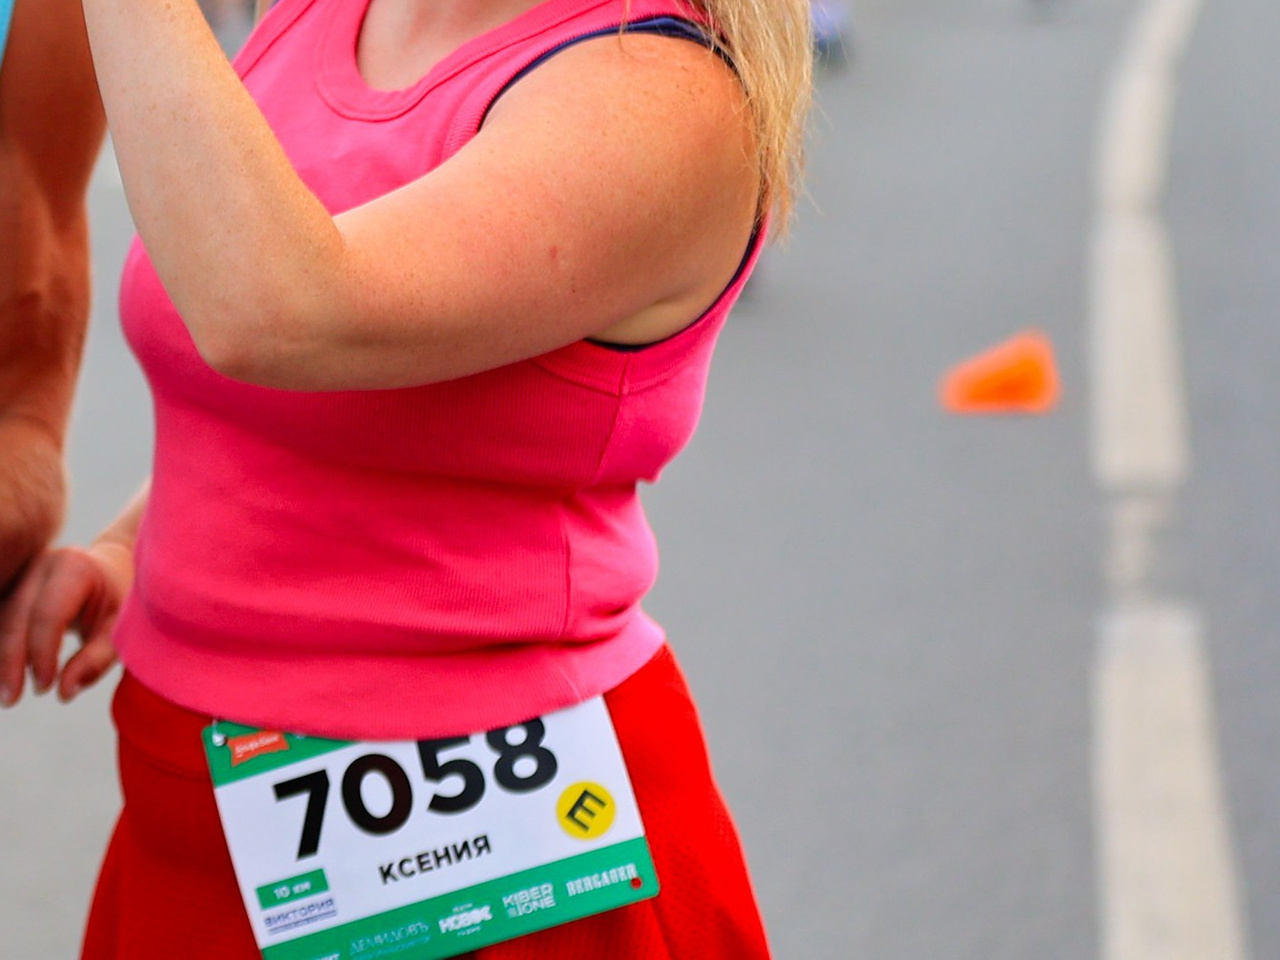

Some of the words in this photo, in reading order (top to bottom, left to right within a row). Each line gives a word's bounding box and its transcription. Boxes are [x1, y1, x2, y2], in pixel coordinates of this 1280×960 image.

[273, 716, 558, 862] 7058
[379, 835, 492, 885] КСЕНИЯ
[273, 885, 291, 900] 10
[502, 882, 554, 908] KIBER
